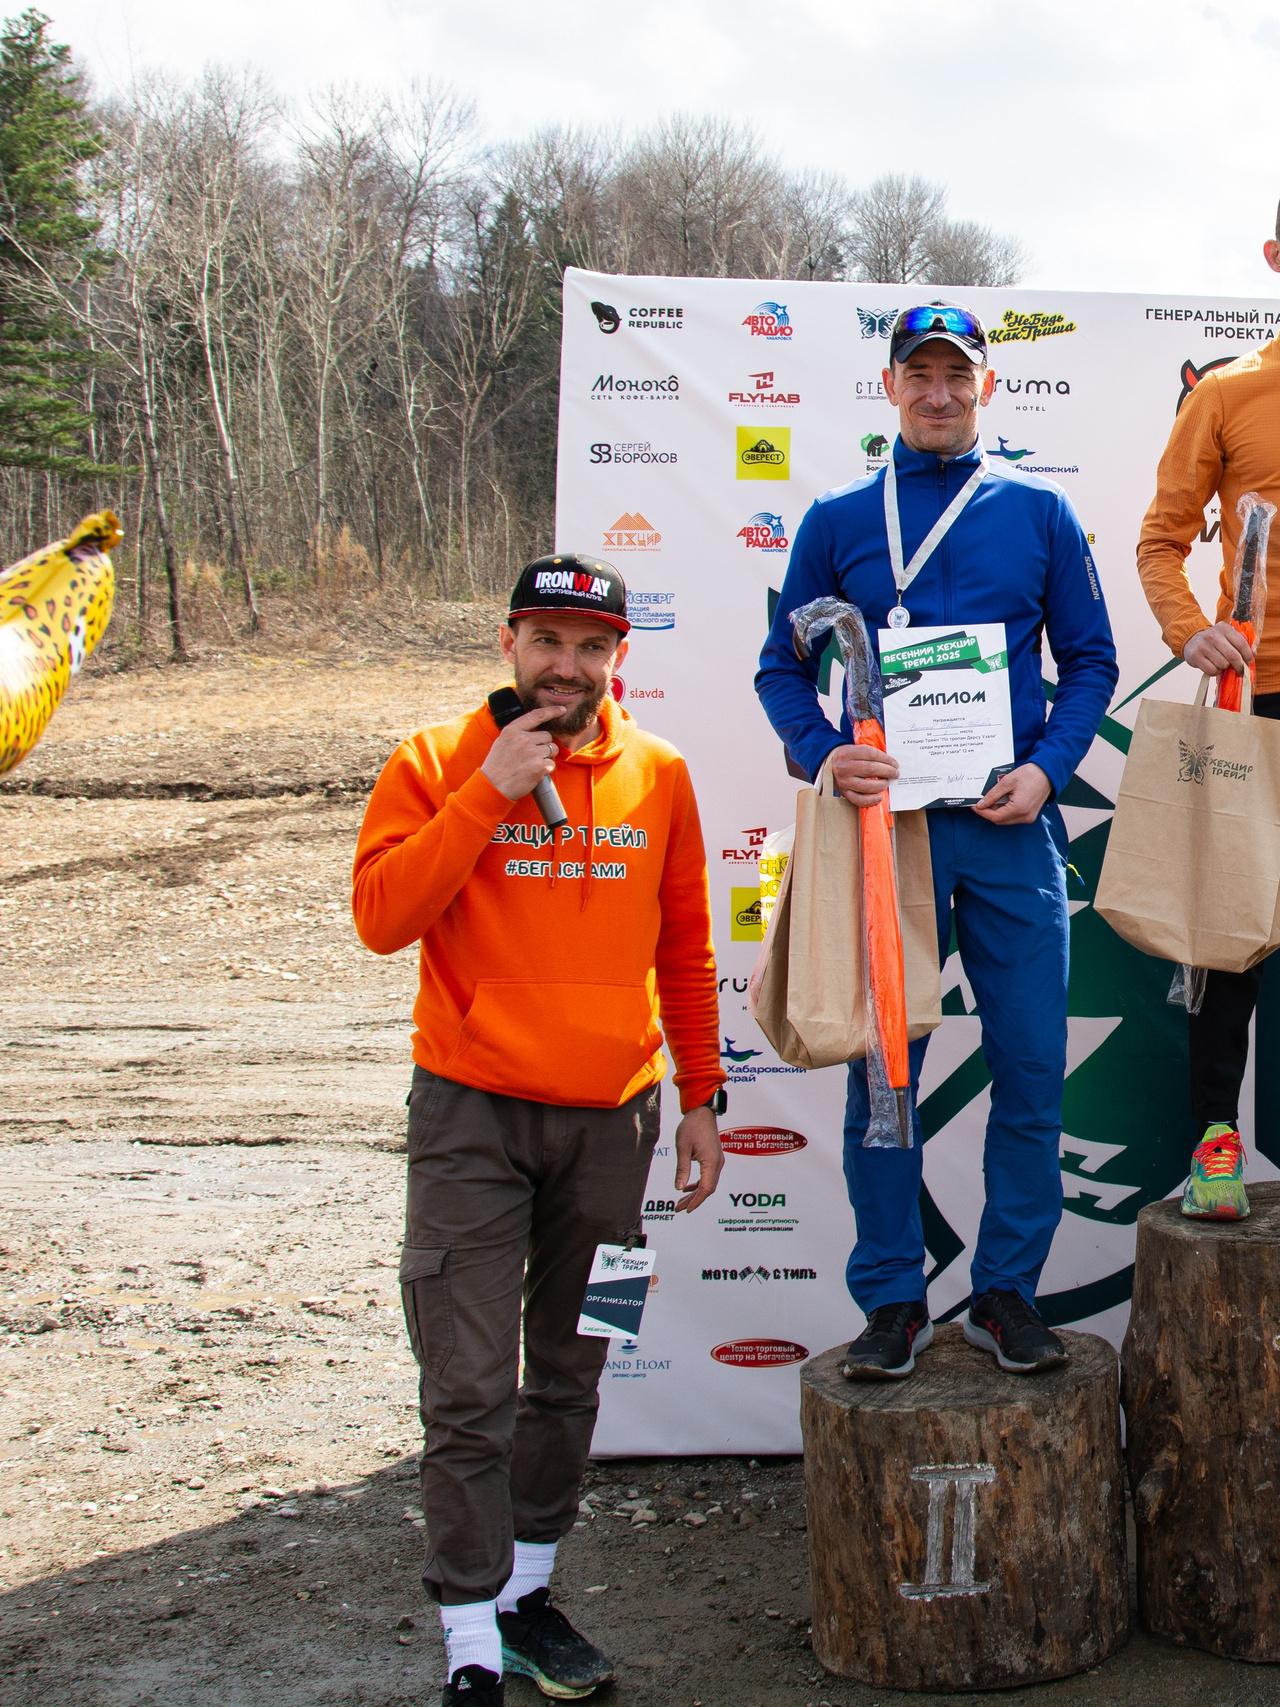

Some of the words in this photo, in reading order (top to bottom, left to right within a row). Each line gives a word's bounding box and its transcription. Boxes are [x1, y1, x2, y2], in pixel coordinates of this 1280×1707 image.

[629, 307, 684, 318] COFFEE
[1145, 308, 1260, 324] ГЕНЕРАЛЬНЫЙ
[628, 320, 684, 329] REPUBLIC
[741, 315, 776, 326] АВТО
[751, 325, 793, 336] РАДИО
[1204, 326, 1275, 340] ПРОЕКТА
[856, 381, 883, 395] СТЕ
[728, 392, 801, 404] FLYHAB
[614, 441, 651, 452] СЕРГЕЙ
[614, 453, 678, 464] БОРОХОВ
[744, 453, 781, 461] ЭВЕРЕСТ
[1012, 464, 1079, 473] баровский
[736, 526, 771, 537] АВТО
[745, 537, 789, 548] РАДИО
[1084, 555, 1101, 600] SALOMON
[535, 571, 611, 597] IRONWAY
[539, 588, 586, 598] СПОРТИВНЫЙ
[626, 590, 675, 604] ЙСБЕРГ
[936, 637, 976, 652] ХЕХЦИР
[936, 650, 961, 662] 2025
[629, 687, 664, 699] slavda
[908, 690, 986, 707] ДИПЛОМ
[1209, 758, 1254, 773] ХЕХЦИР
[490, 823, 574, 849] ЕХЦИР
[577, 823, 648, 849] ТРЕЙЛ
[722, 849, 761, 860] FLYH
[727, 1064, 807, 1075] Хабаровский
[727, 1074, 756, 1083] край
[724, 1131, 794, 1141] "Техно-торговый
[756, 1140, 799, 1149] Богачёва"
[729, 1193, 786, 1207] YODA
[644, 1200, 675, 1212] ДВА
[621, 1258, 649, 1267] ХЕХЦИР
[702, 1268, 738, 1280] МОТО
[586, 1294, 644, 1307] ОРГАНИЗАТОР
[726, 1344, 795, 1353] "Техно-торговый
[719, 1353, 744, 1362] центр
[745, 1353, 756, 1361] на
[757, 1352, 801, 1361] Богачёва"
[604, 1360, 632, 1370] AND
